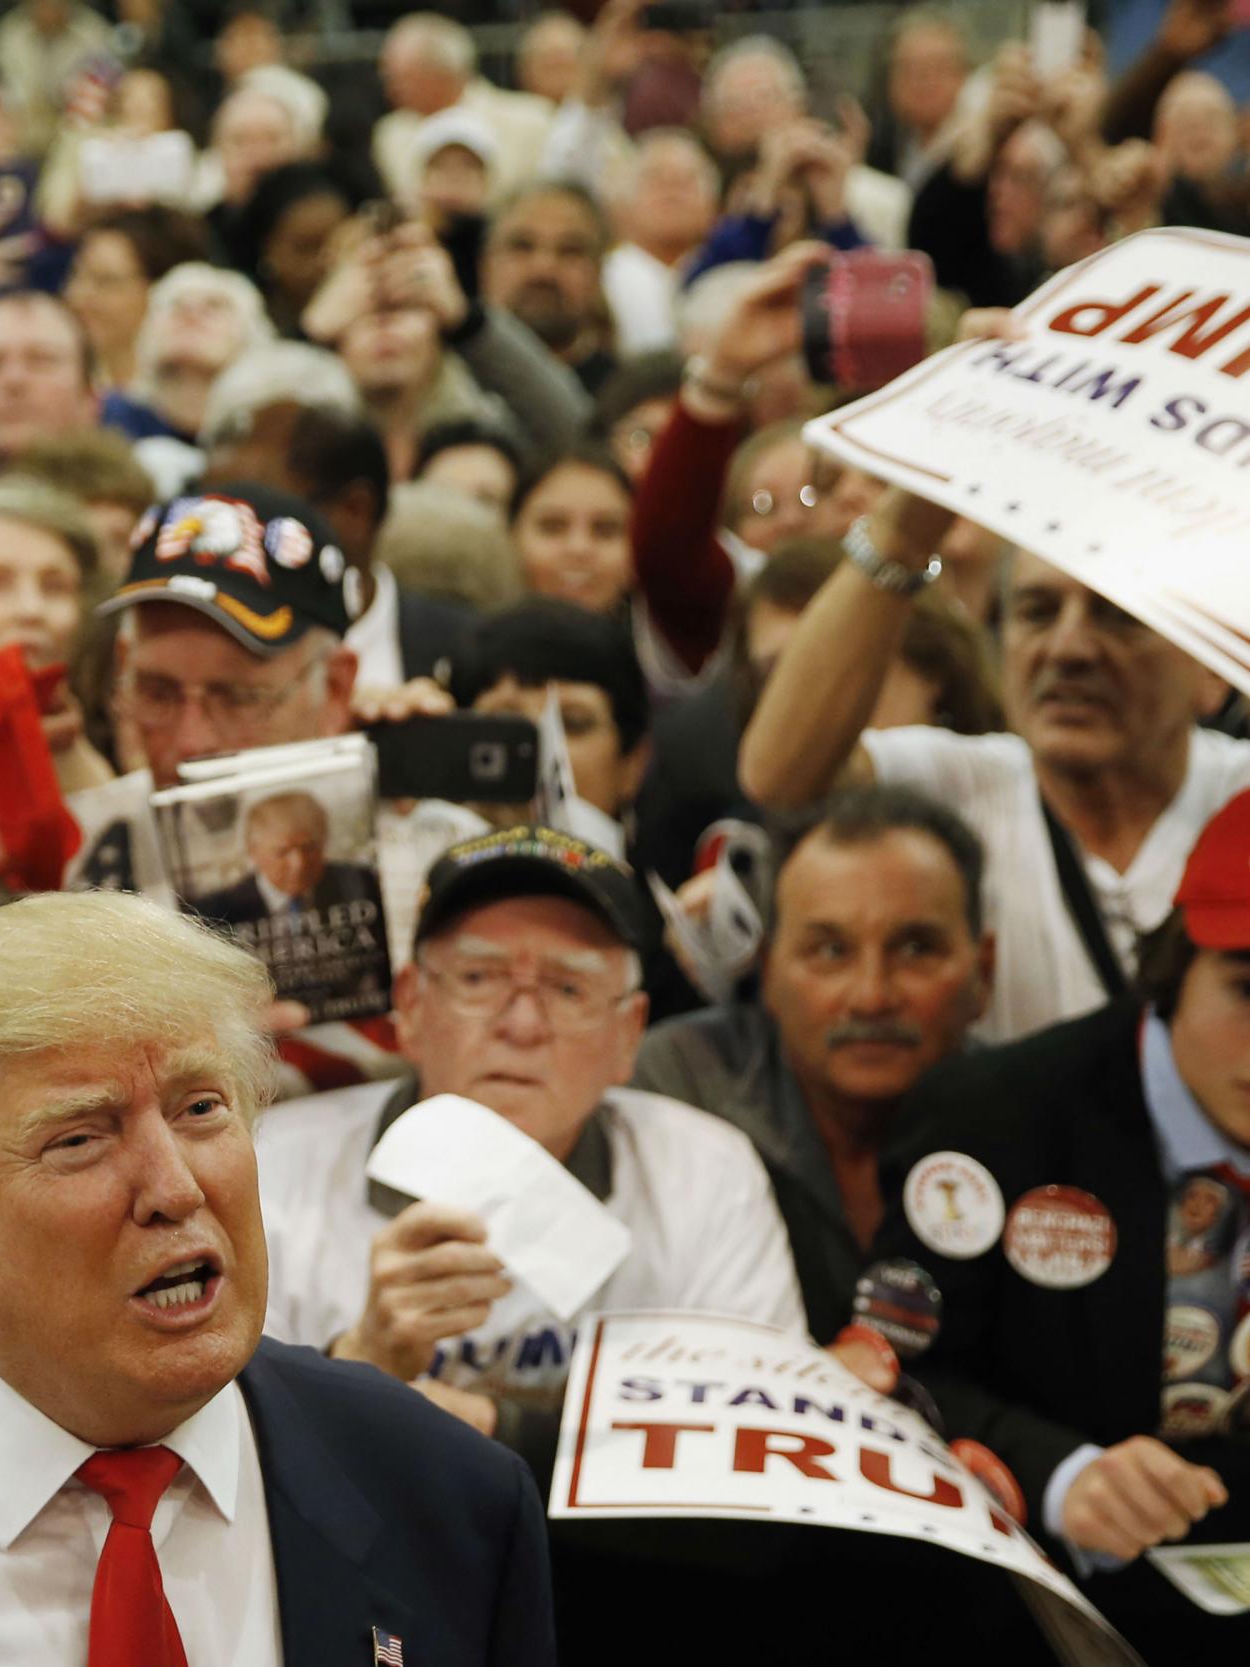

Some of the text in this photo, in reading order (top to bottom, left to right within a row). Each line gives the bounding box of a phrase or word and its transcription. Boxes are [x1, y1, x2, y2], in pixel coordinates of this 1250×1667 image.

[971, 342, 1250, 468] DS WITH
[611, 1422, 1012, 1537] TRU
